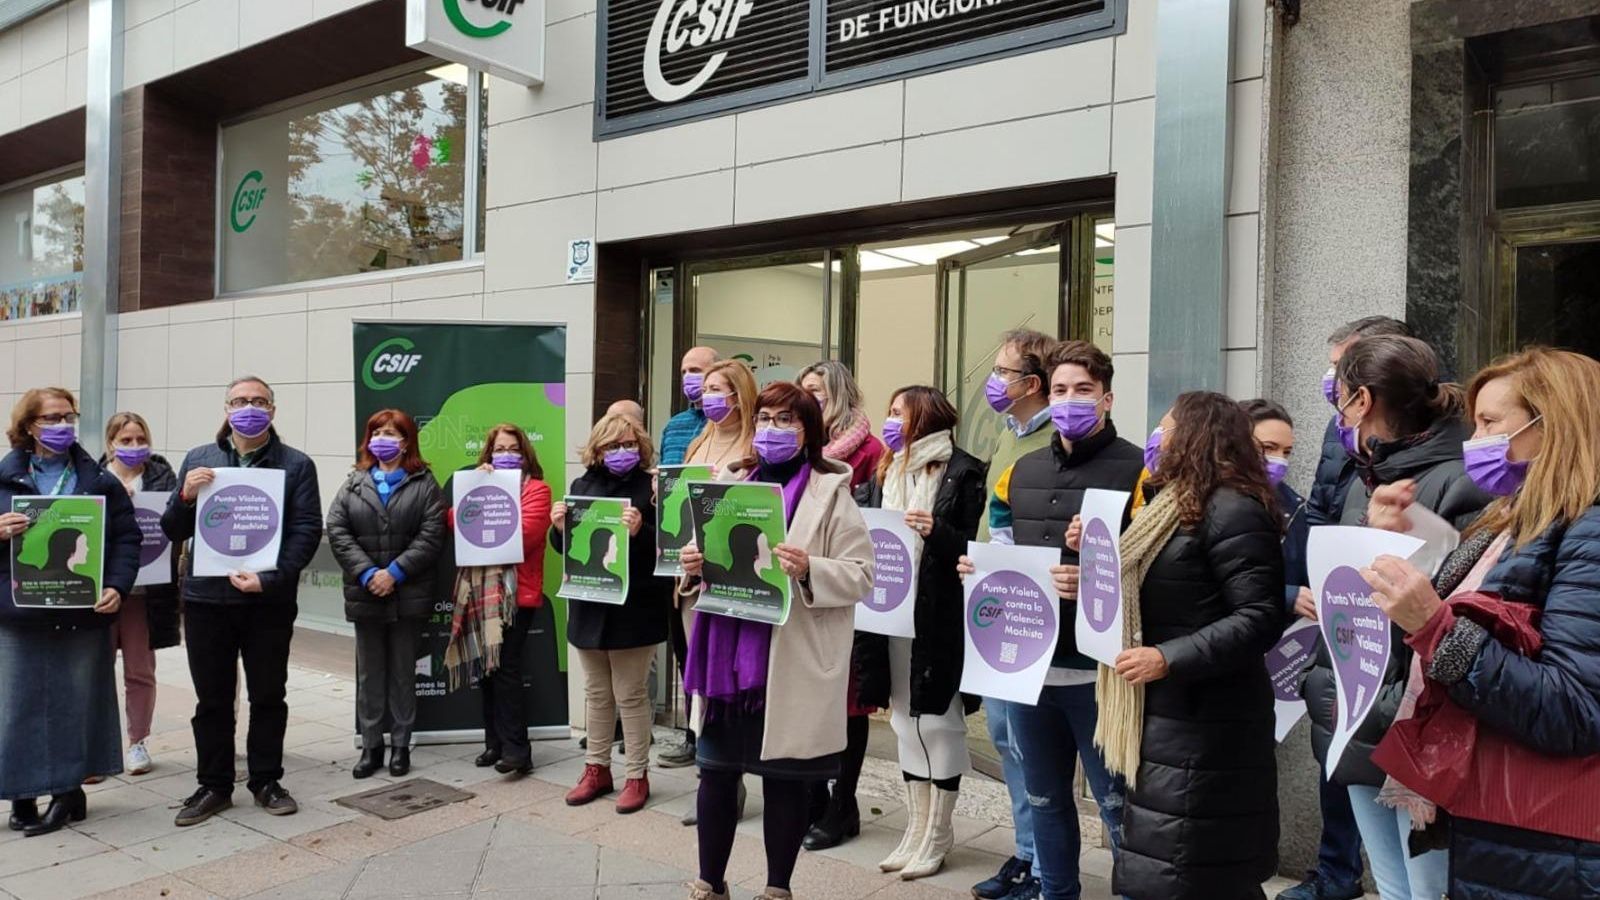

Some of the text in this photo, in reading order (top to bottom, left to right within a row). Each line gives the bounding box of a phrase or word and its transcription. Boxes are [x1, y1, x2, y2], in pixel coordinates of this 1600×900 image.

[840, 13, 871, 43] DE
[373, 353, 422, 373] CSIF
[465, 440, 479, 450] de
[213, 494, 267, 503] Punto Violeta
[261, 503, 269, 511] la
[232, 512, 270, 521] Violencia
[232, 522, 269, 530] Machista
[880, 541, 902, 550] Violeta
[876, 562, 905, 573] Violencia
[876, 573, 905, 584] Machista
[982, 583, 1040, 599] Punto Violeta
[1325, 590, 1349, 606] Punto
[979, 606, 1003, 619] CSIF
[1005, 601, 1043, 613] contra la
[1004, 611, 1045, 626] Violencia
[1352, 614, 1377, 631] contra
[1004, 625, 1043, 640] Machista
[1336, 627, 1355, 646] CSIF
[415, 689, 447, 698] alabra
